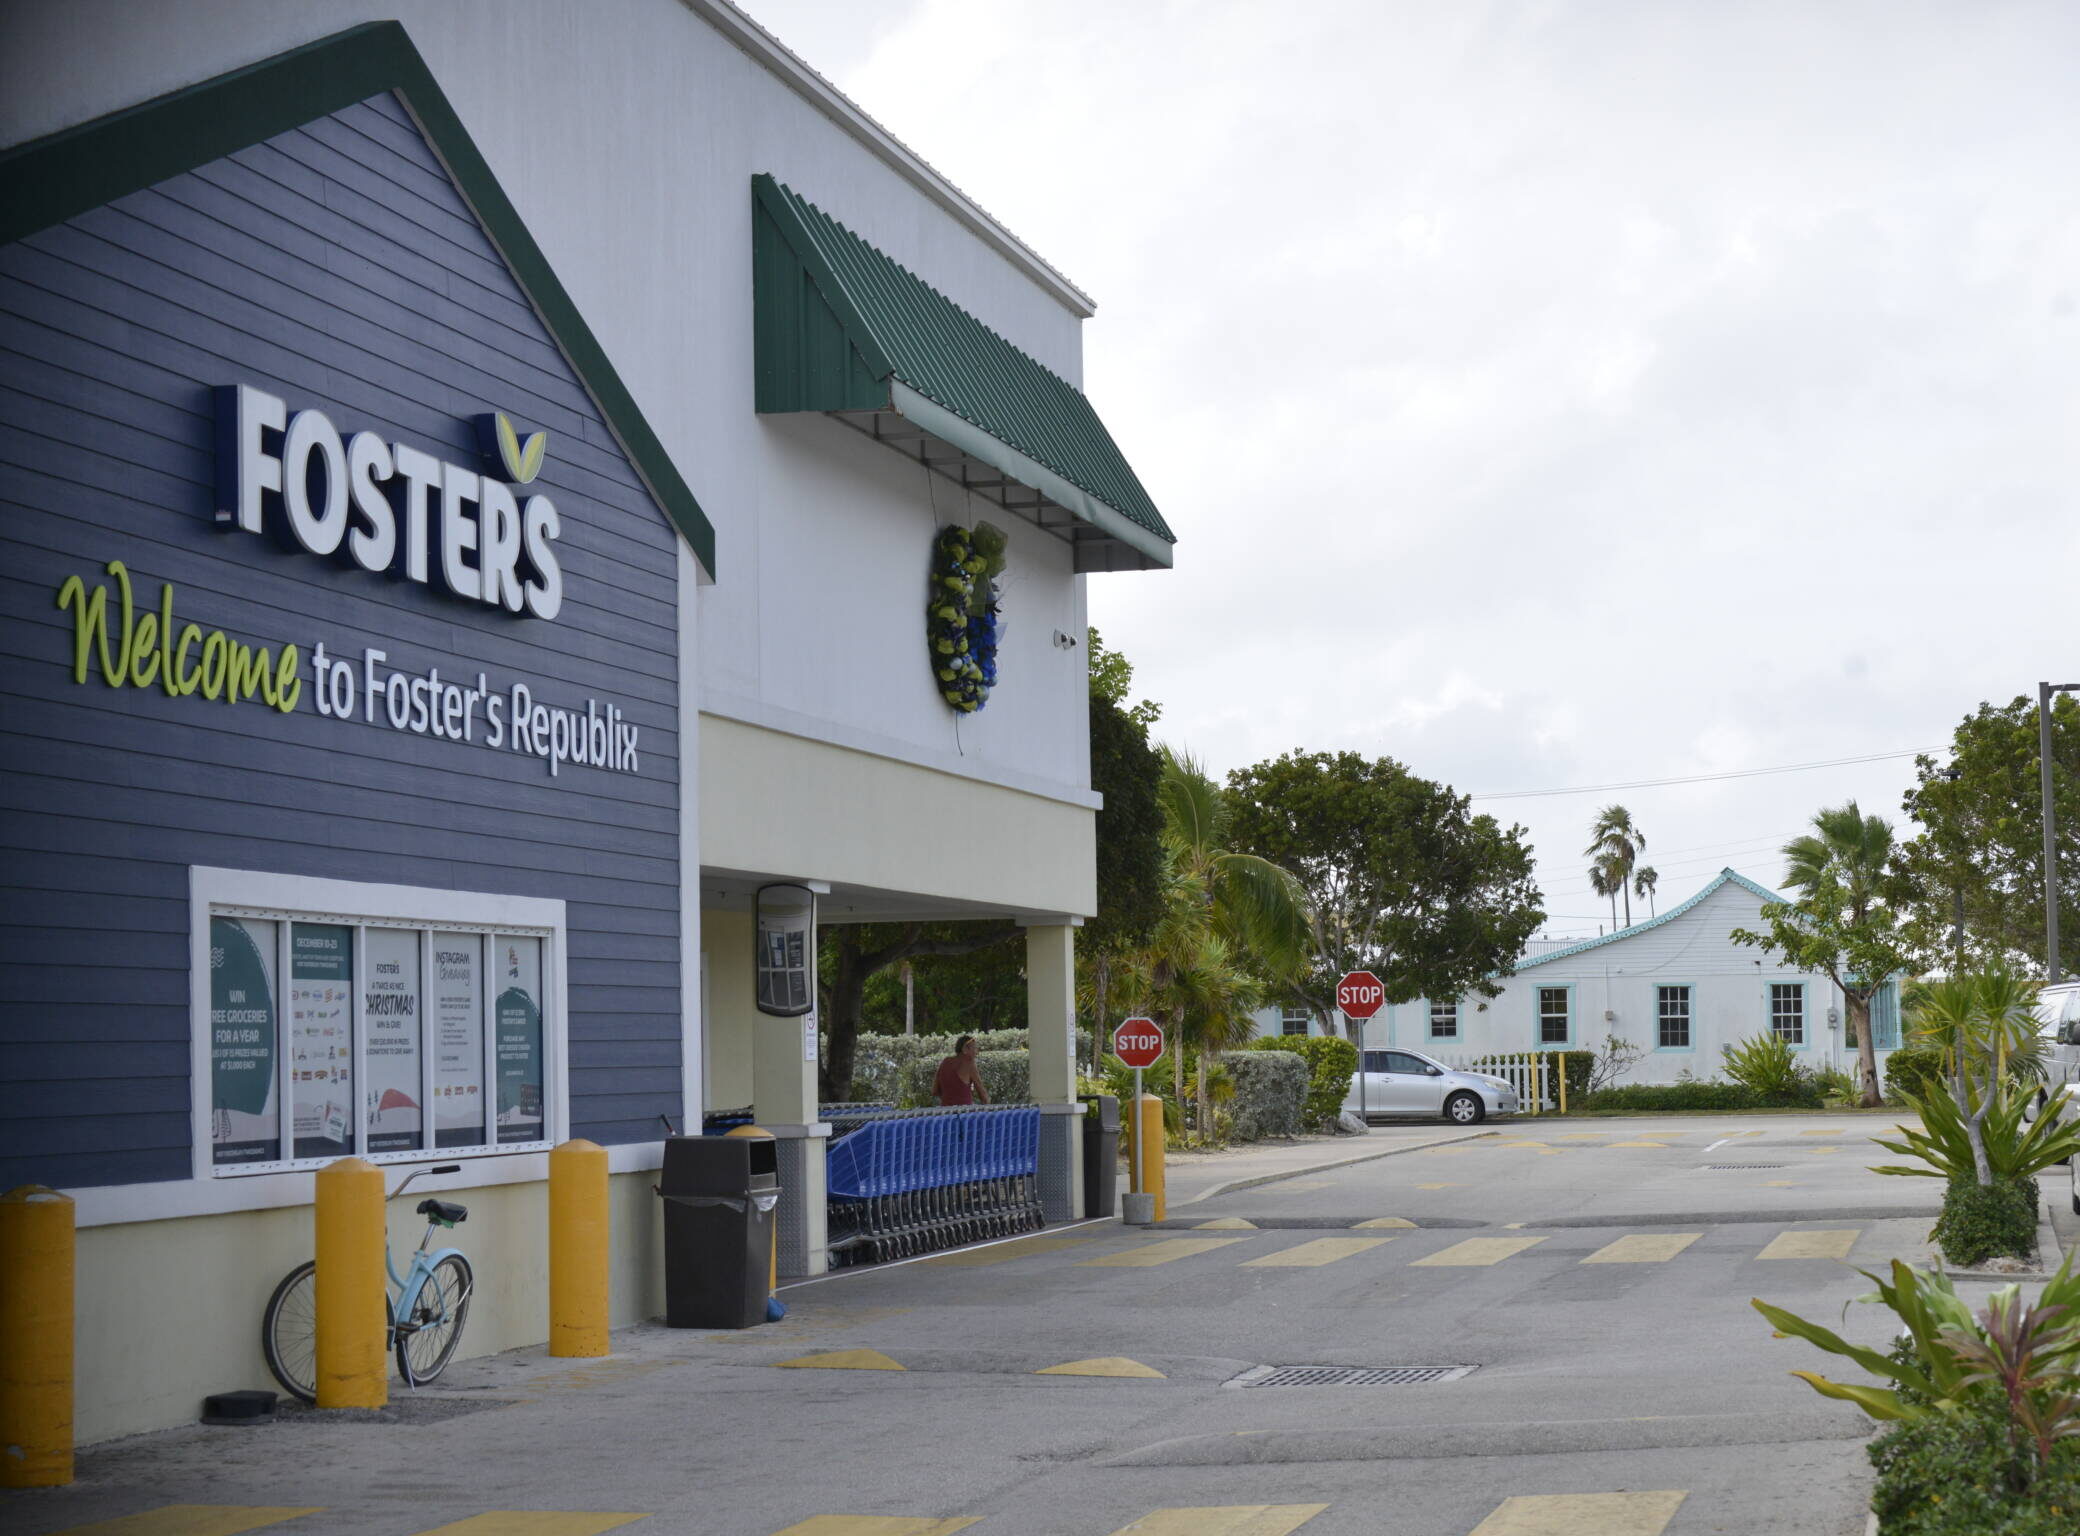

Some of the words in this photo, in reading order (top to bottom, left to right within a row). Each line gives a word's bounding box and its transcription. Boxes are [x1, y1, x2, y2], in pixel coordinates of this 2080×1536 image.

[57, 560, 300, 714] Welcome
[312, 641, 354, 719] to
[364, 648, 502, 748] Foster's
[511, 683, 638, 777] Republix
[435, 951, 470, 965] INSTAGRAM
[229, 990, 246, 1003] WIN
[1340, 986, 1381, 1004] STOP
[227, 1009, 267, 1023] GROCERIES
[216, 1030, 232, 1043] FOR
[233, 1030, 239, 1042] A
[240, 1029, 260, 1042] YEAR
[1118, 1035, 1159, 1051] STOP
